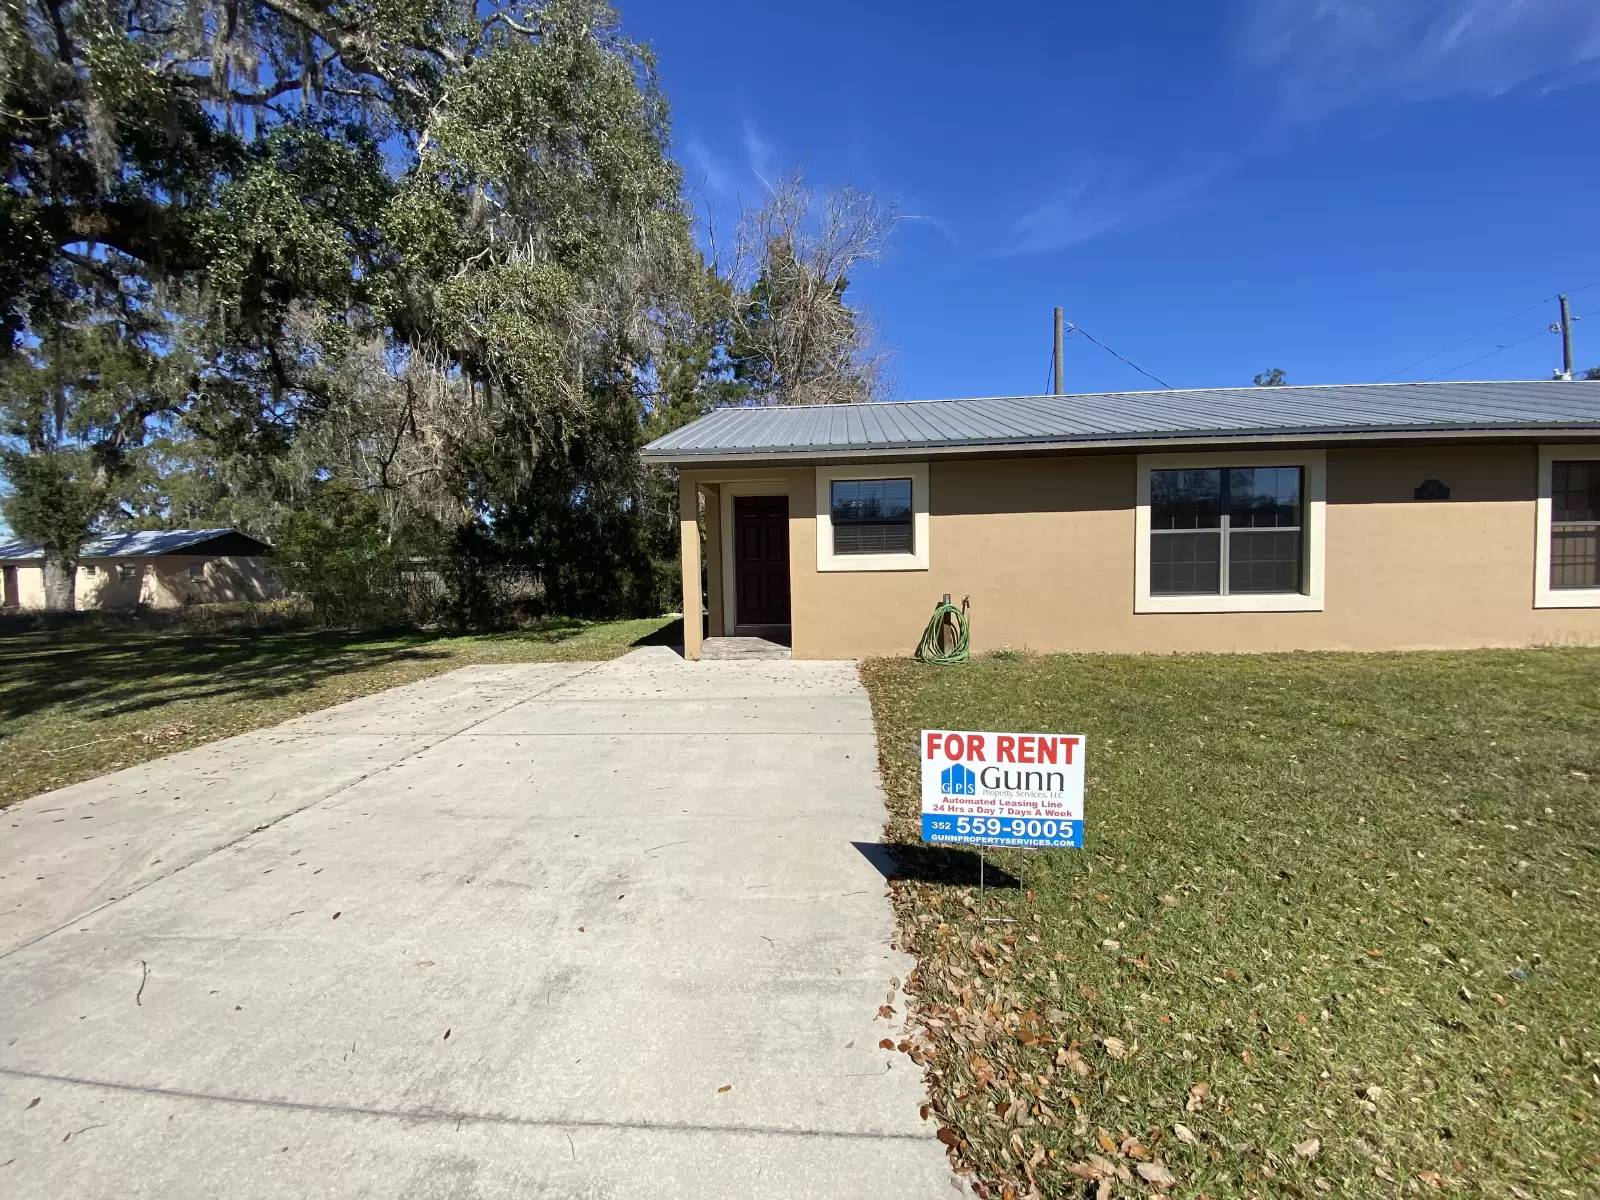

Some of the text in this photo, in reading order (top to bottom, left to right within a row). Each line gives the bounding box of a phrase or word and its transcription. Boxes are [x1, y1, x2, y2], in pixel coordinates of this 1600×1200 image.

[927, 733, 1079, 764] FOR RENT
[980, 766, 1064, 791] Gunn
[941, 783, 975, 794] GPS
[982, 789, 1013, 798] Property
[942, 796, 1063, 809] Automated Leasing Line
[949, 805, 965, 813] Hrs
[976, 807, 995, 815] Day
[1007, 808, 1032, 816] Days
[931, 817, 1074, 838] 352 559-9005
[931, 833, 1075, 846] GUNNPROPERTYSERVICES.COM
